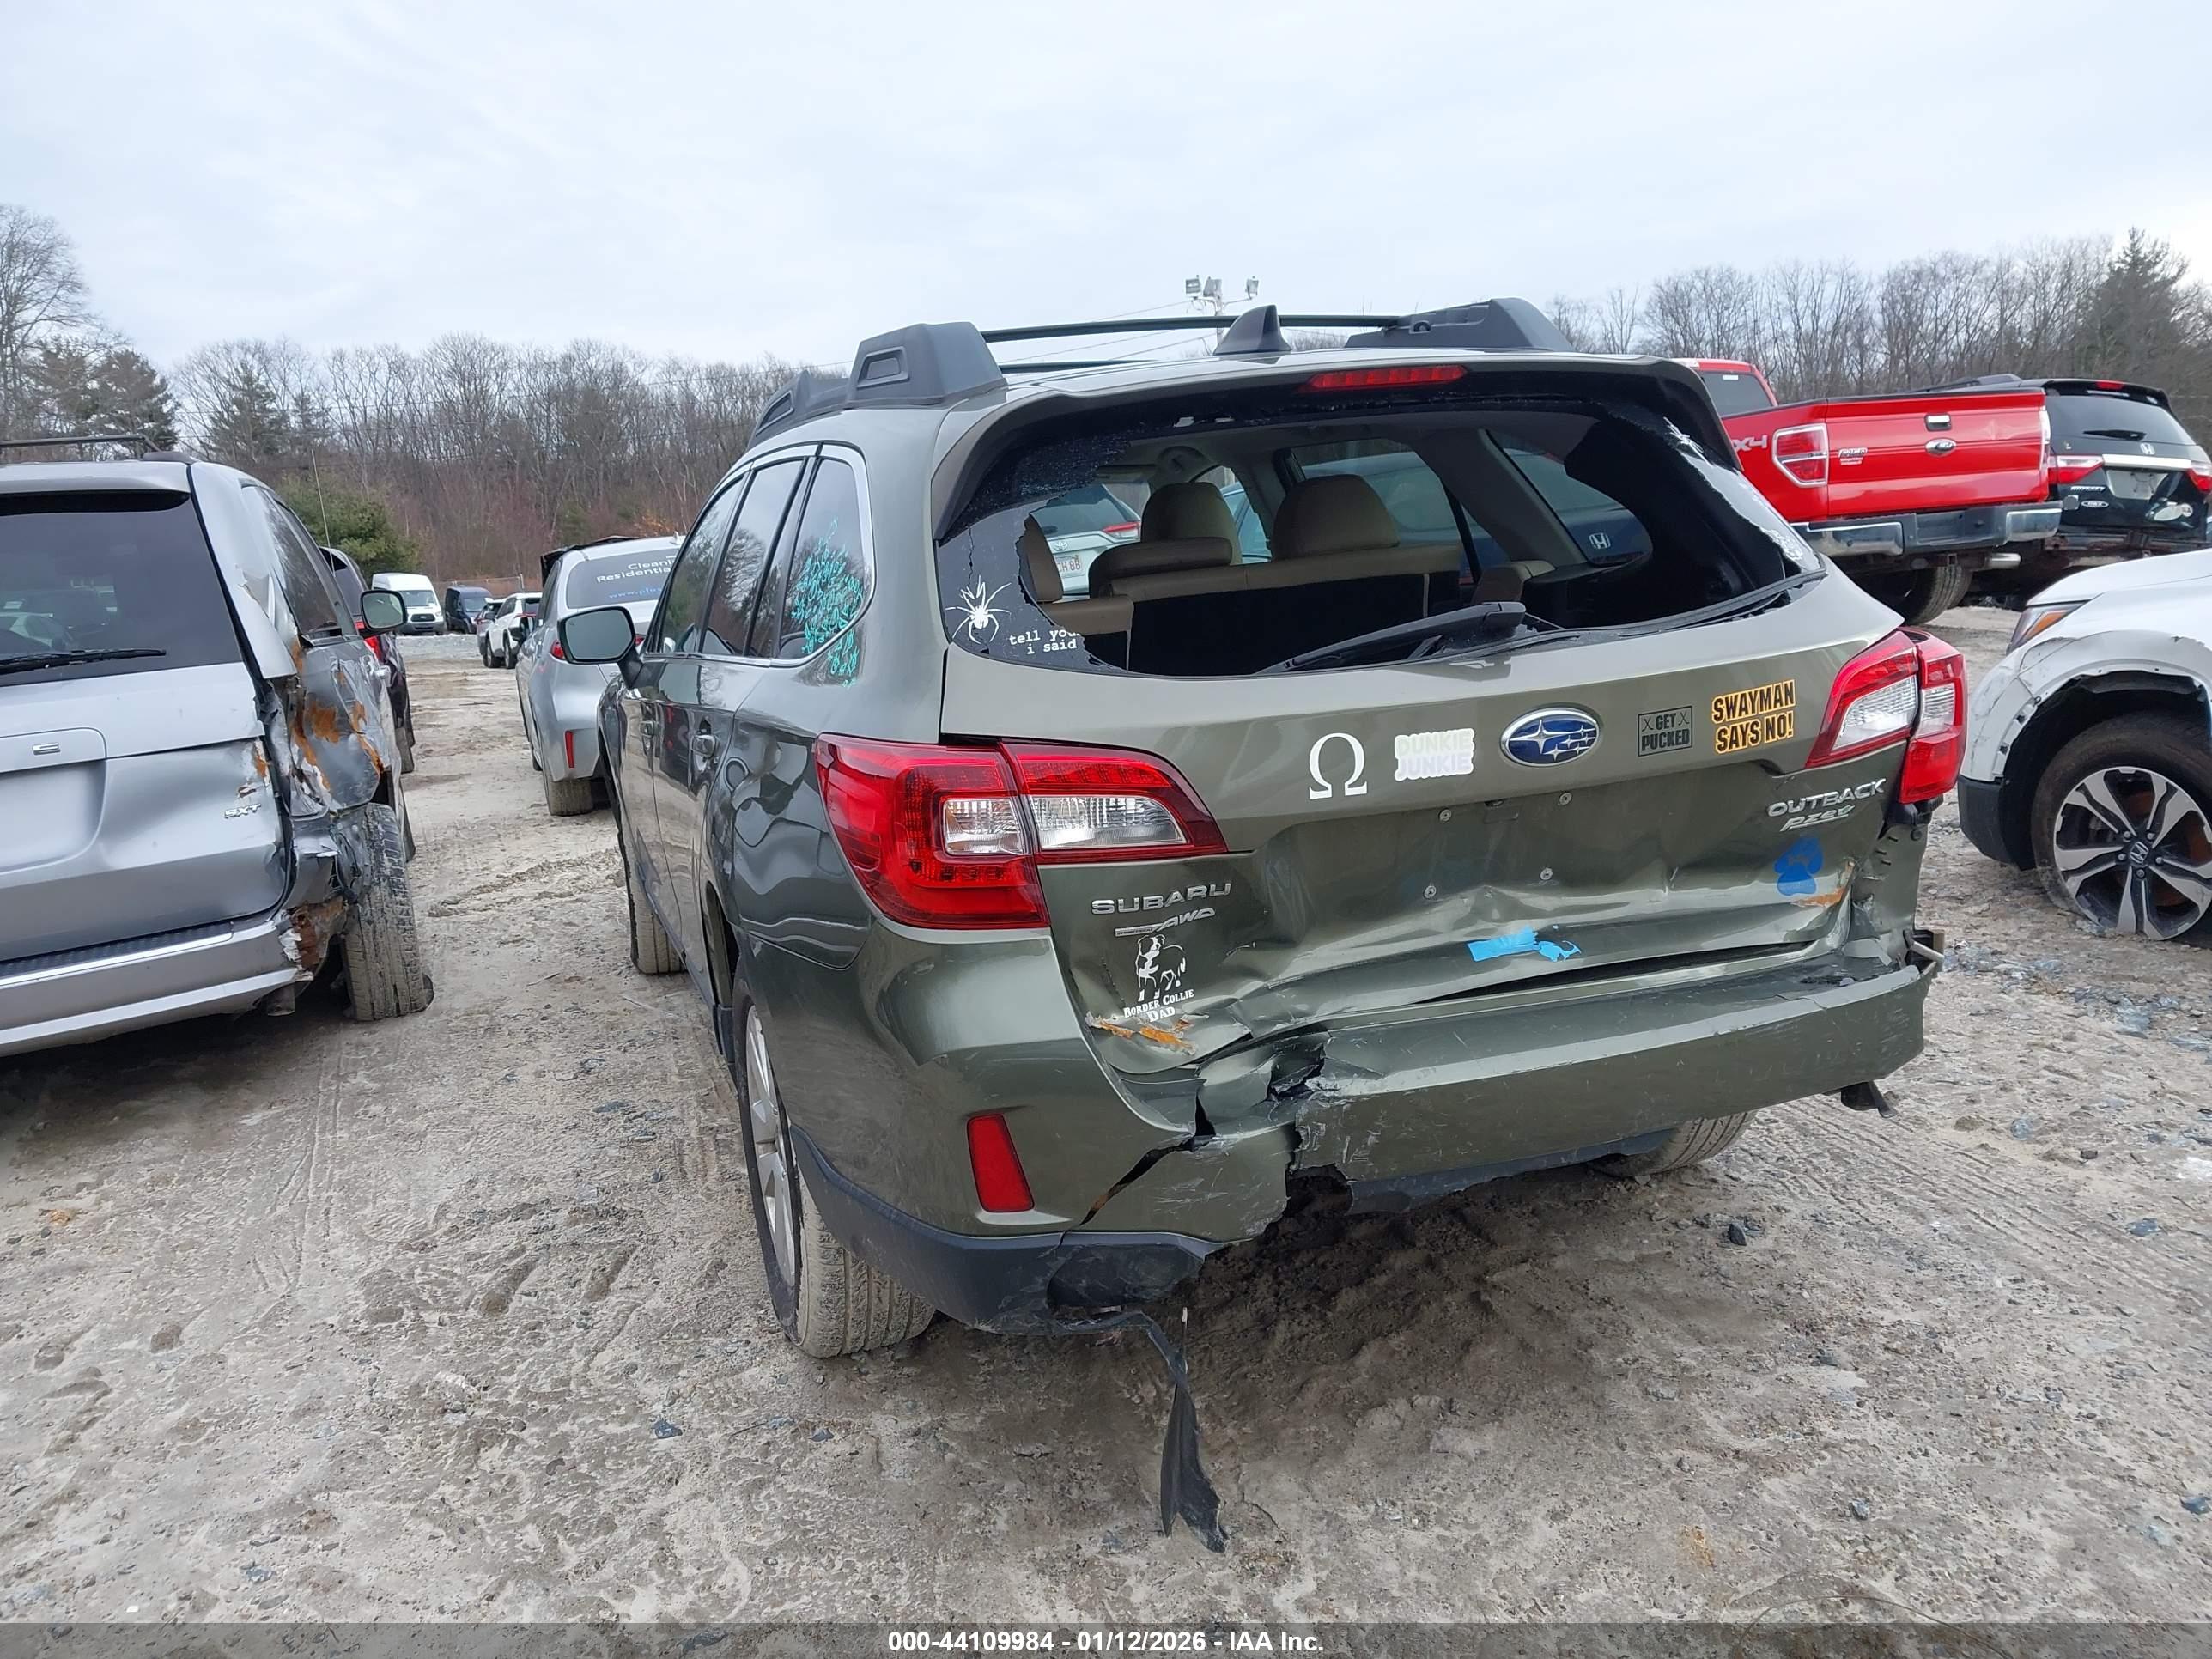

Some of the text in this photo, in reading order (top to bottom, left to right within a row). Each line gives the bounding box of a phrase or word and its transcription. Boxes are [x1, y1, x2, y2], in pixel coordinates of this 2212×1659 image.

[1009, 629, 1041, 646] tell
[1026, 638, 1078, 655] i said
[1712, 680, 1795, 722] SWAYMAN
[1656, 713, 1677, 730] GET
[1717, 712, 1794, 753] SAYS NO!
[1395, 732, 1470, 756] DUNKIE
[1641, 729, 1690, 751] PUCKED
[1397, 753, 1470, 777] JUNKIE
[1768, 778, 1887, 817] OUTBACK
[225, 804, 261, 818] SXT
[1091, 883, 1231, 915] SUBARU
[1157, 908, 1216, 932] AWD
